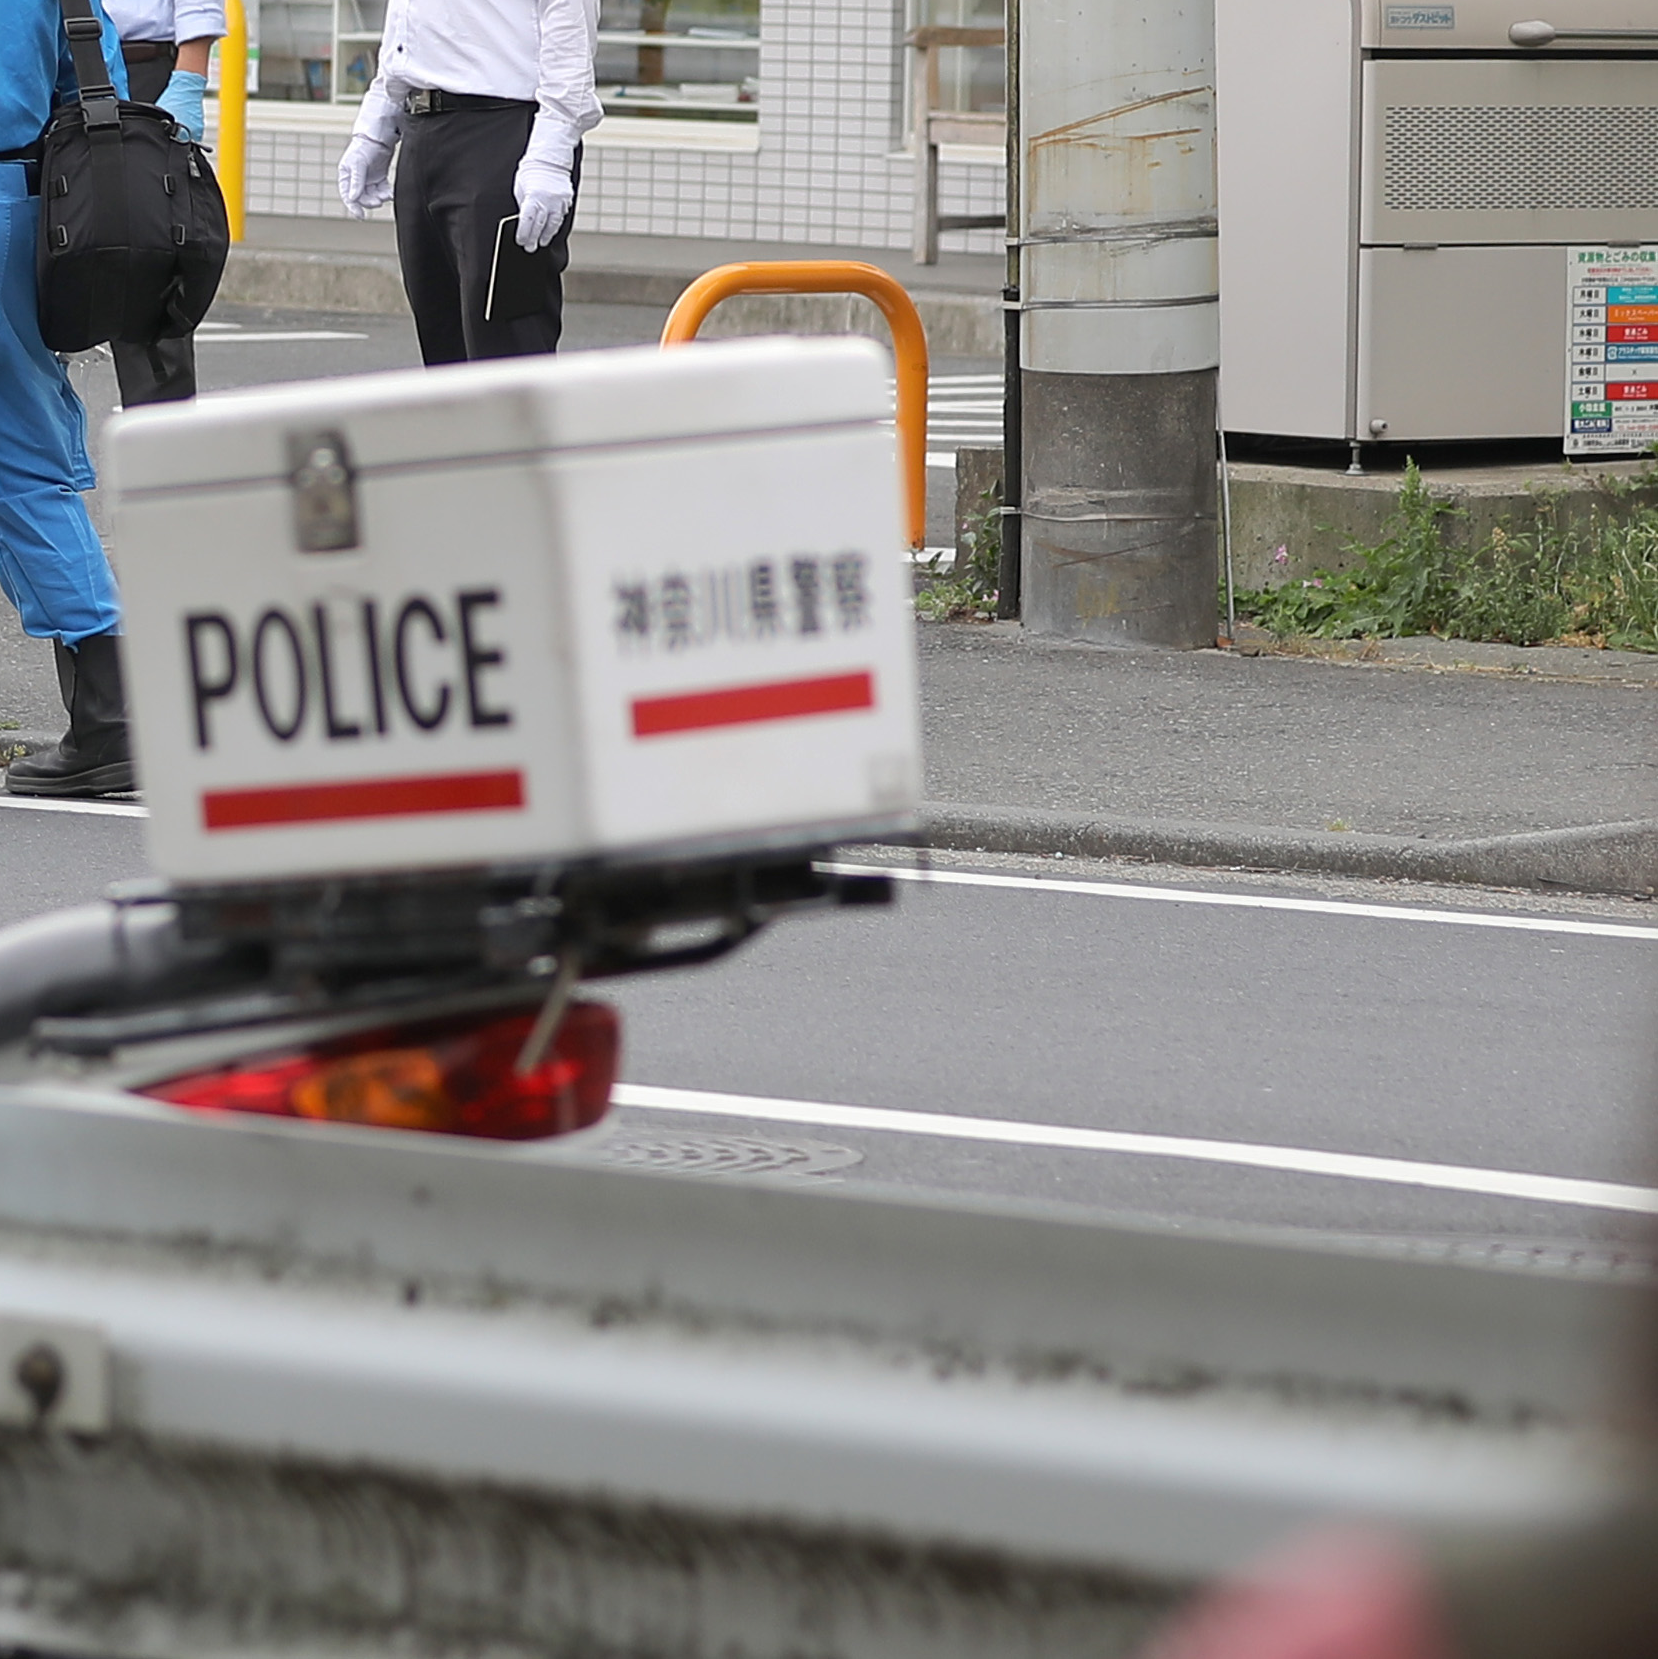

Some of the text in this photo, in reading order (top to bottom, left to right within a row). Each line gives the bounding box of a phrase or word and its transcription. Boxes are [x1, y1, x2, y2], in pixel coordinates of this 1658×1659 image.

[612, 551, 873, 652] 神奈川県警察
[183, 588, 513, 752] POLICE
